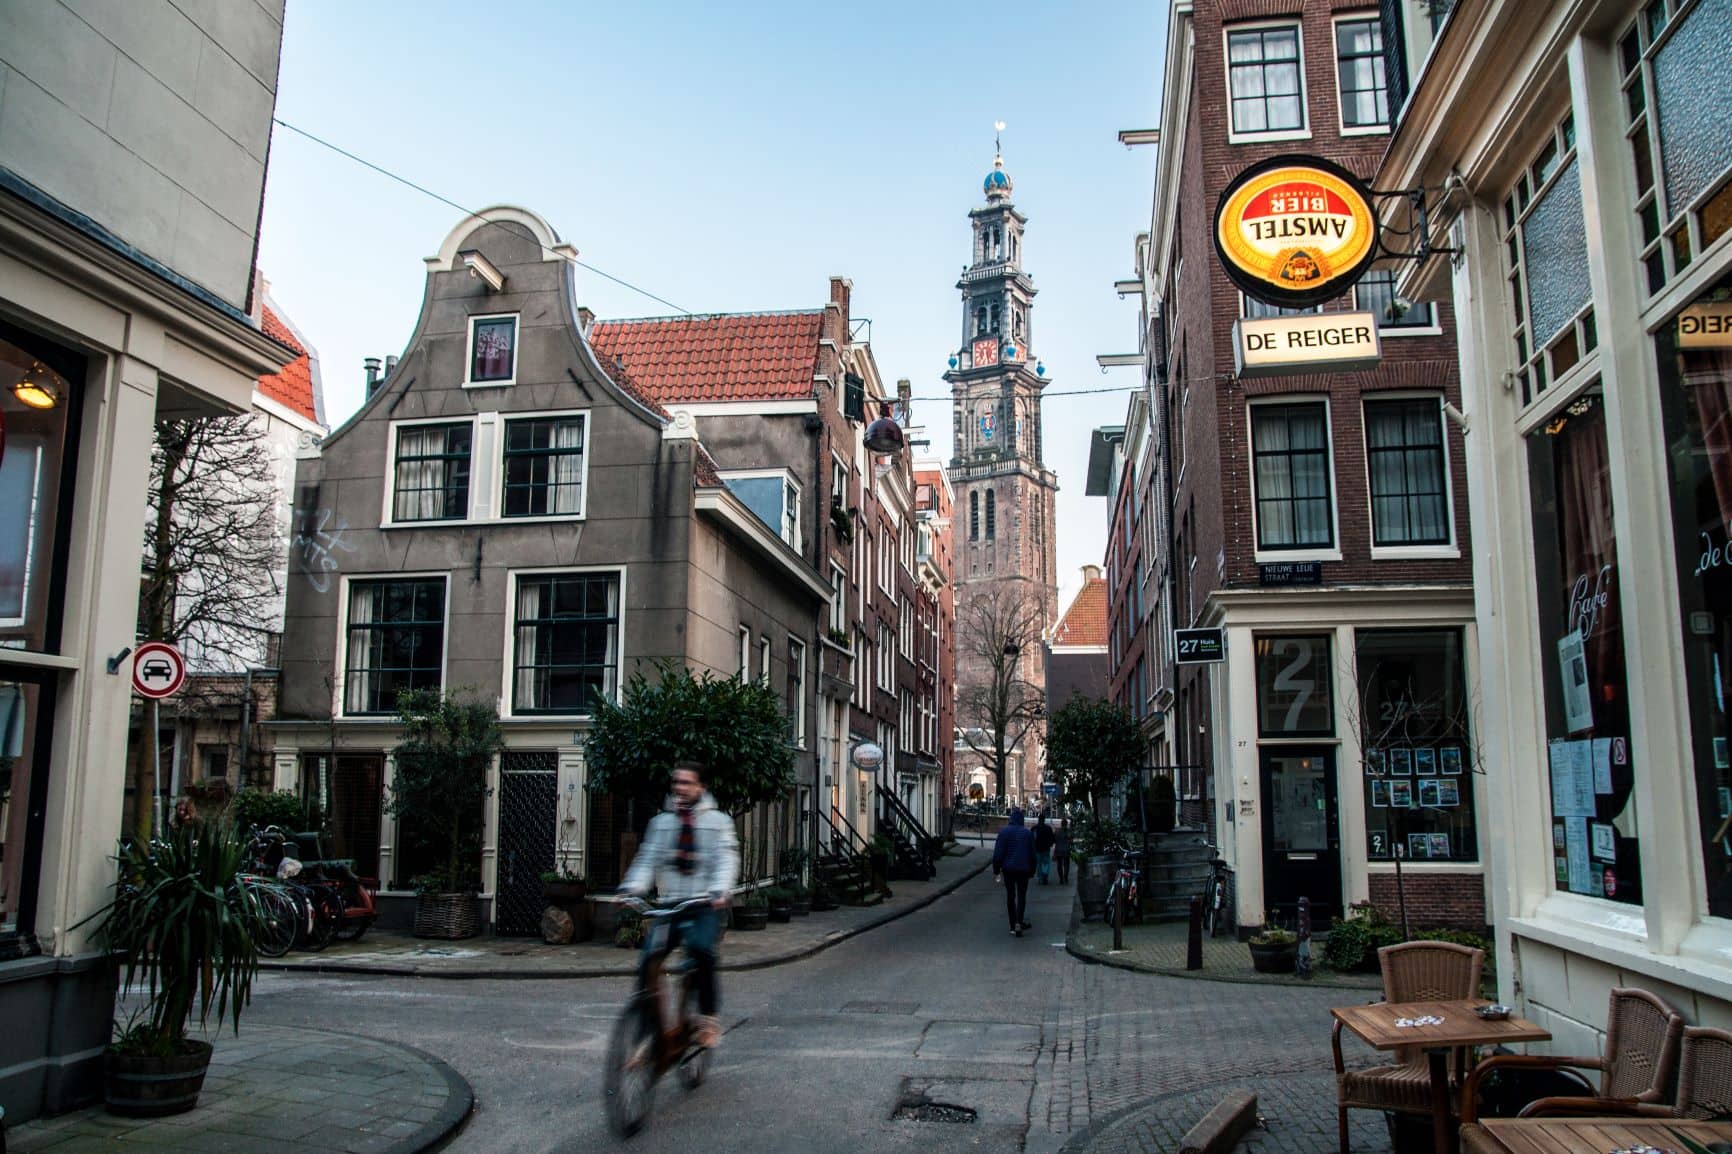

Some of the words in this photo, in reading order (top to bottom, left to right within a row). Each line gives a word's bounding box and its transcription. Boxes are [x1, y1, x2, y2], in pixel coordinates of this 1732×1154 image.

[1271, 197, 1324, 214] BIER
[1250, 216, 1347, 241] AMSTEL
[1246, 333, 1277, 351] DE
[1287, 326, 1371, 349] REIGER
[1265, 564, 1293, 574] NIEUWE
[1179, 639, 1199, 654] 27
